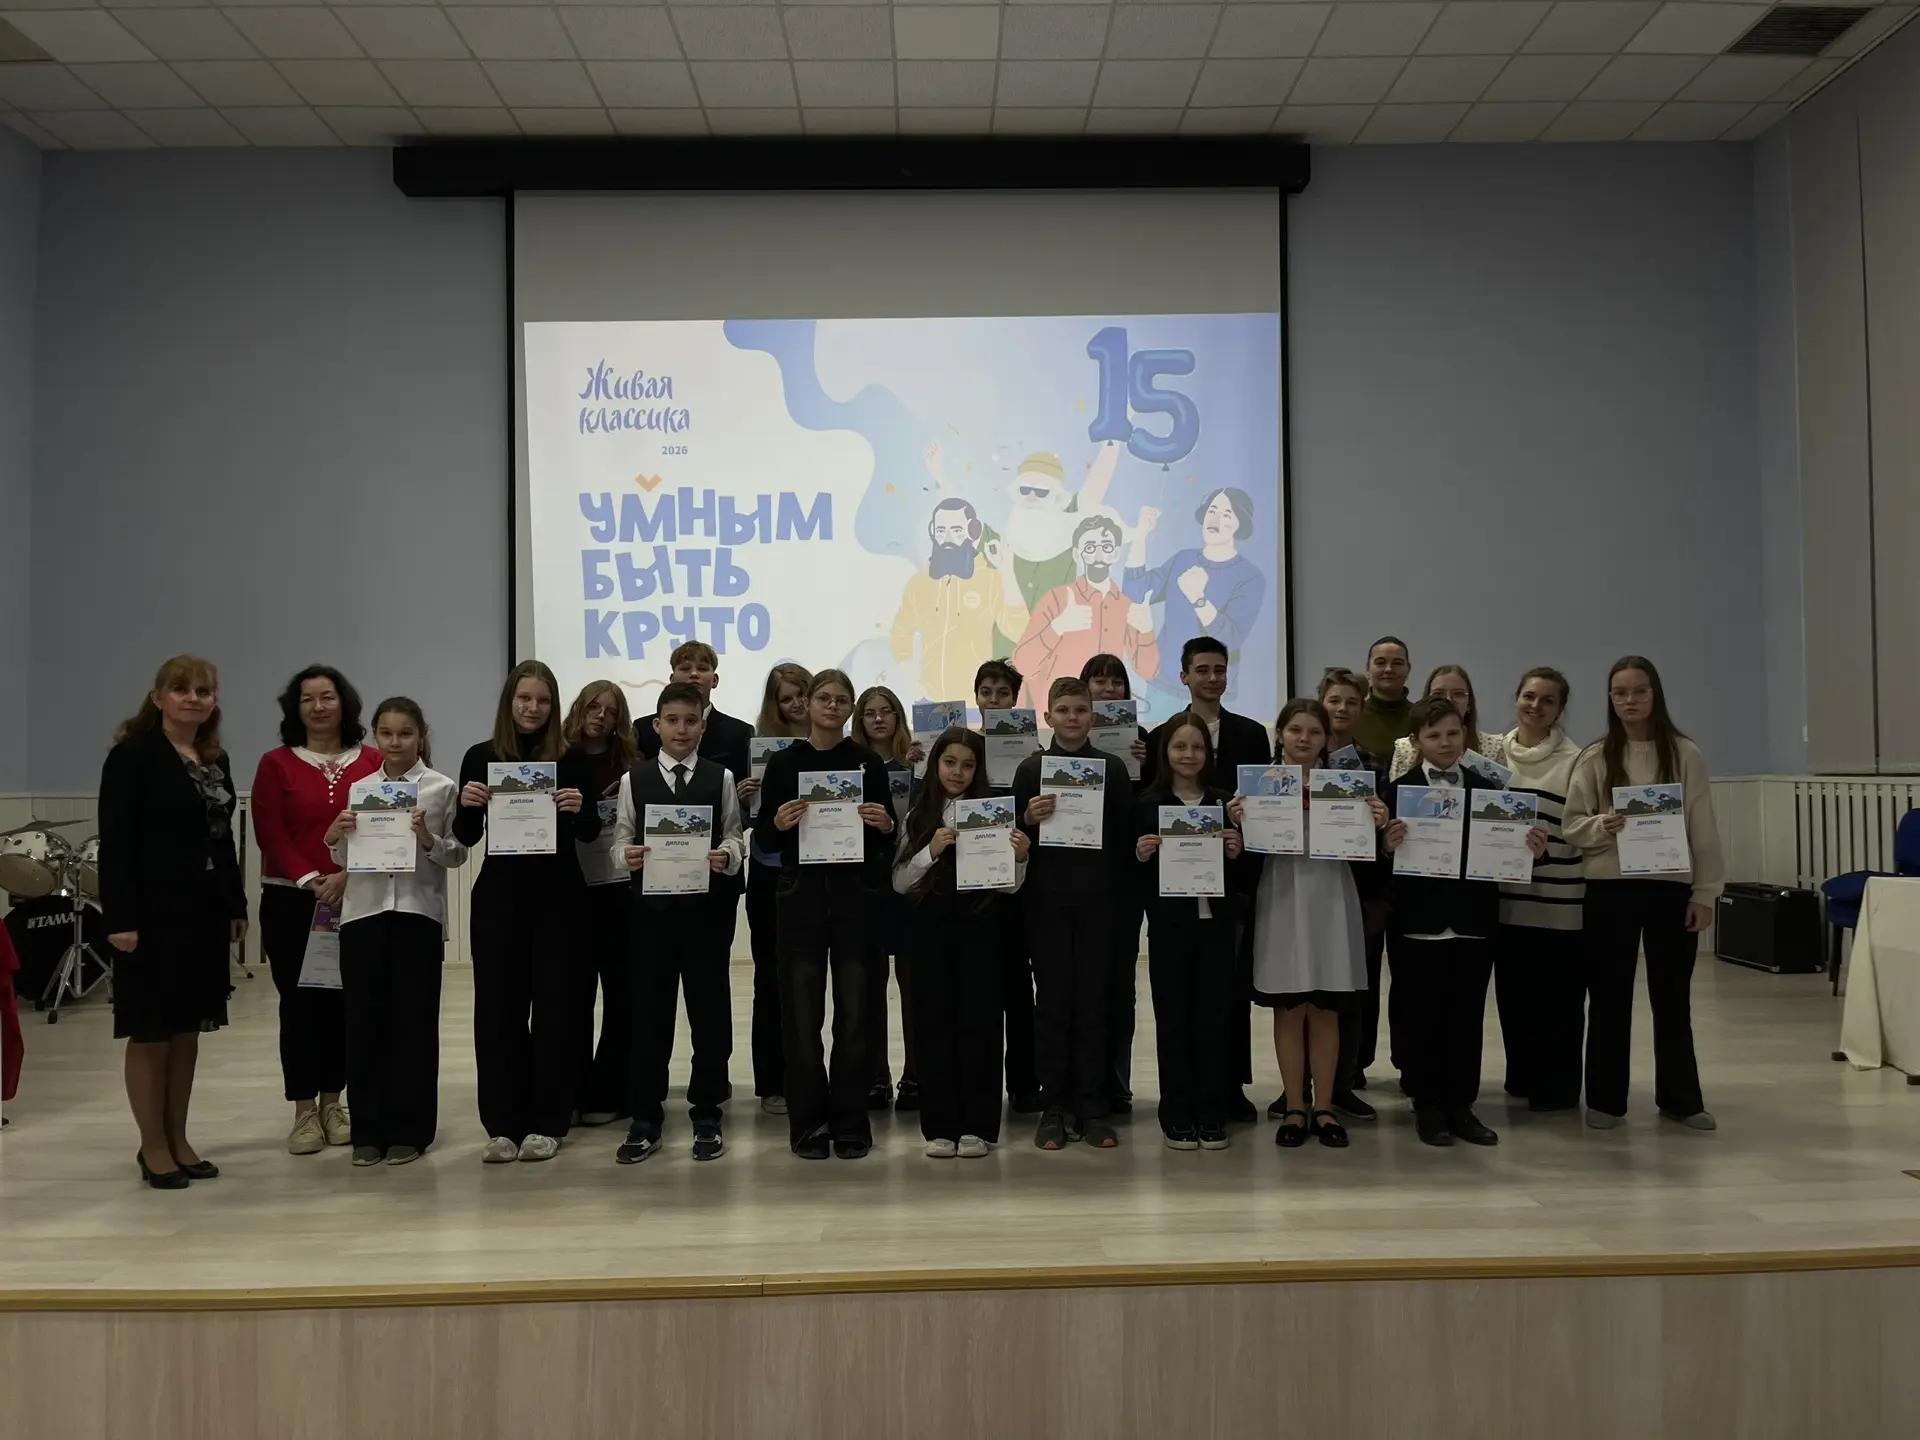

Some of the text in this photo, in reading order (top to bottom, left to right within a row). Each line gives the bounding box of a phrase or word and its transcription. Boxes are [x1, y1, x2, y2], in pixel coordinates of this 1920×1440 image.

[578, 358, 673, 401] Живая
[1086, 326, 1199, 464] 15
[579, 406, 690, 435] классика
[661, 445, 688, 455] 2026
[579, 487, 833, 545] УМНЫМ
[581, 545, 751, 602] БЫТЬ
[584, 602, 770, 660] КРУТО
[36, 911, 76, 928] TAMA
